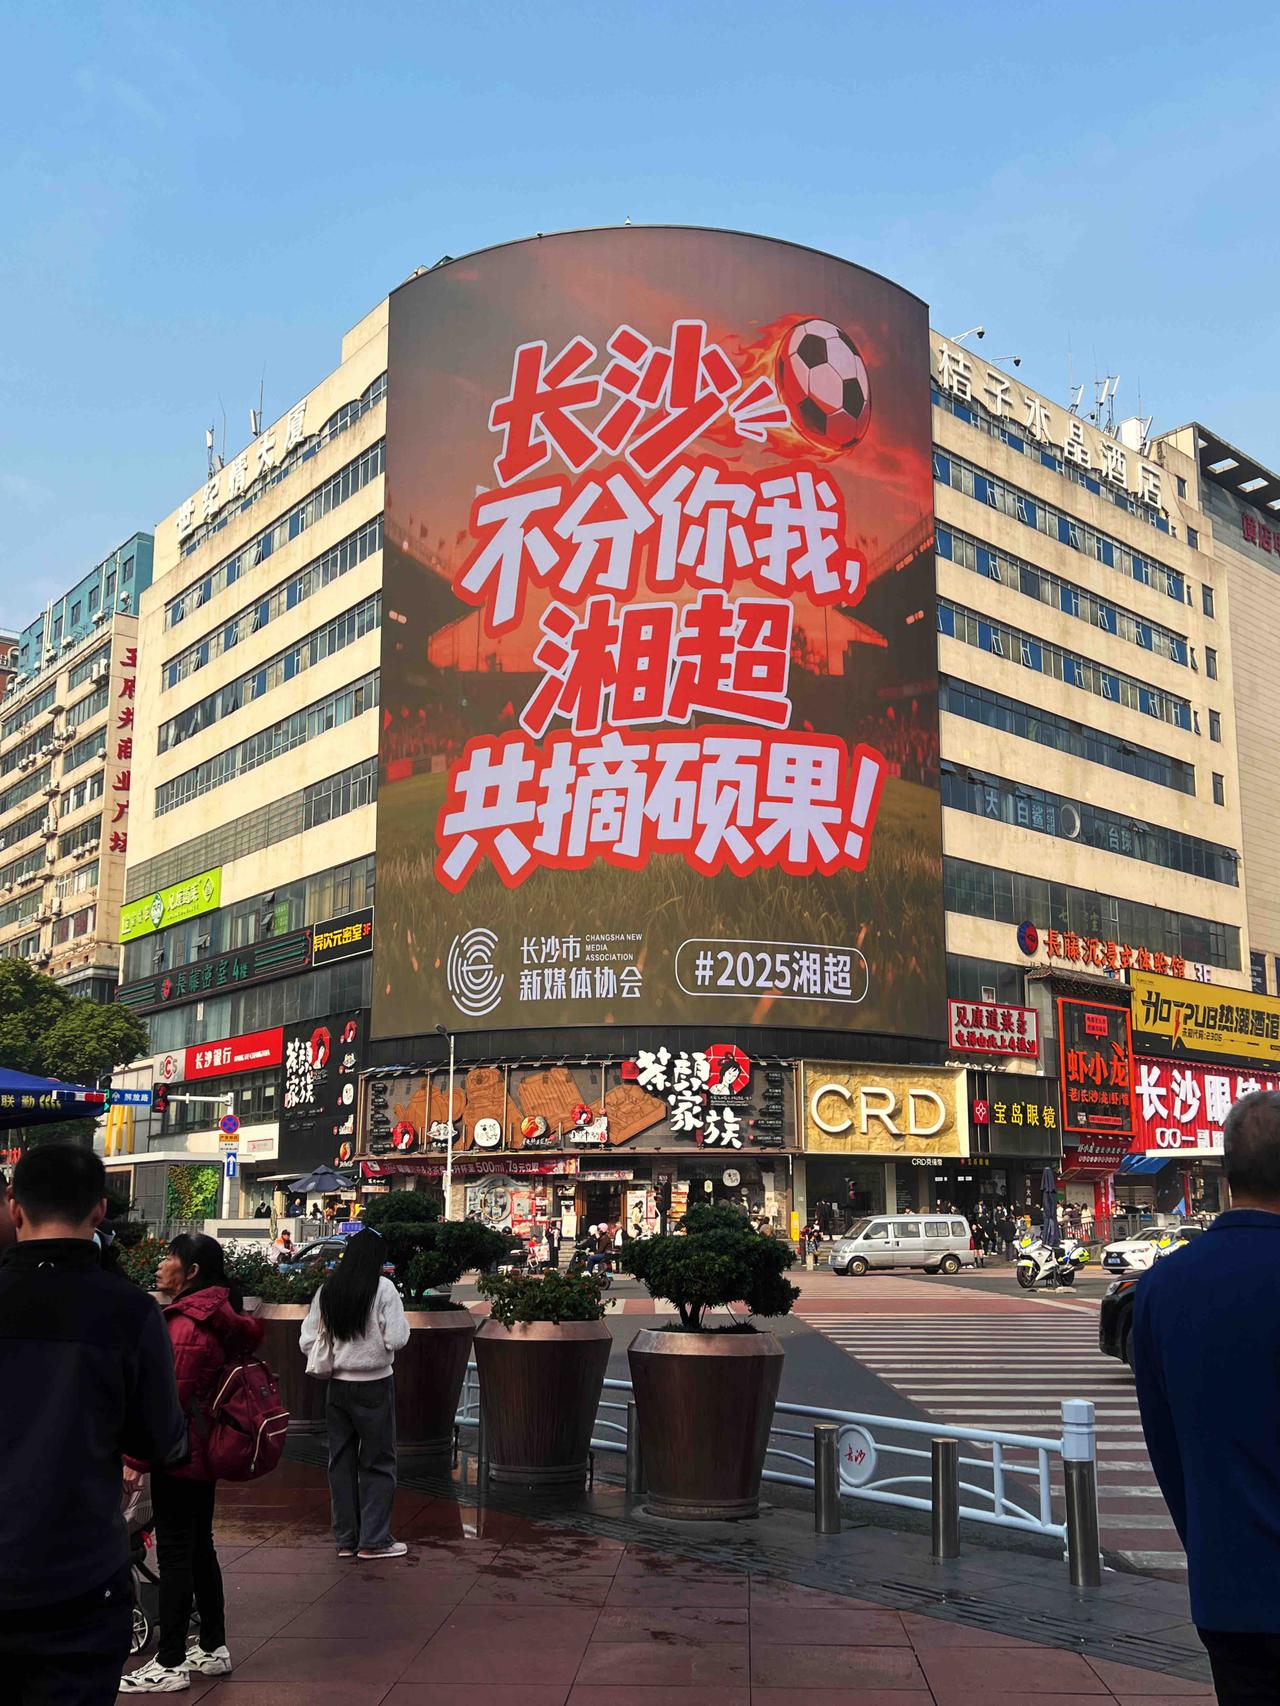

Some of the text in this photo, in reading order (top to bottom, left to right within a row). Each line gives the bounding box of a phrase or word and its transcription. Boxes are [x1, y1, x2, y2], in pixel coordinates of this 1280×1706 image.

[488, 320, 741, 487] 长沙
[938, 343, 1162, 509] 桔子水晶酒店
[518, 589, 793, 738] 湘超
[313, 922, 372, 952] 异次元密室 3F
[520, 935, 581, 964] 长沙市
[585, 933, 643, 942] CHANGSHA NEW
[585, 953, 634, 961] ASSOCIATION
[519, 966, 643, 1001] 新媒体协会
[695, 950, 853, 995] #2025湘超
[159, 1055, 178, 1079] BCS
[195, 1047, 232, 1070] 长沙银行
[1067, 1041, 1129, 1086] 虾小龙
[124, 1093, 149, 1102] 解放路
[810, 1083, 946, 1136] CRD
[667, 1090, 743, 1149] 家族
[993, 1101, 1056, 1130] 宝岛眼镜
[845, 1443, 867, 1465] 长沙
